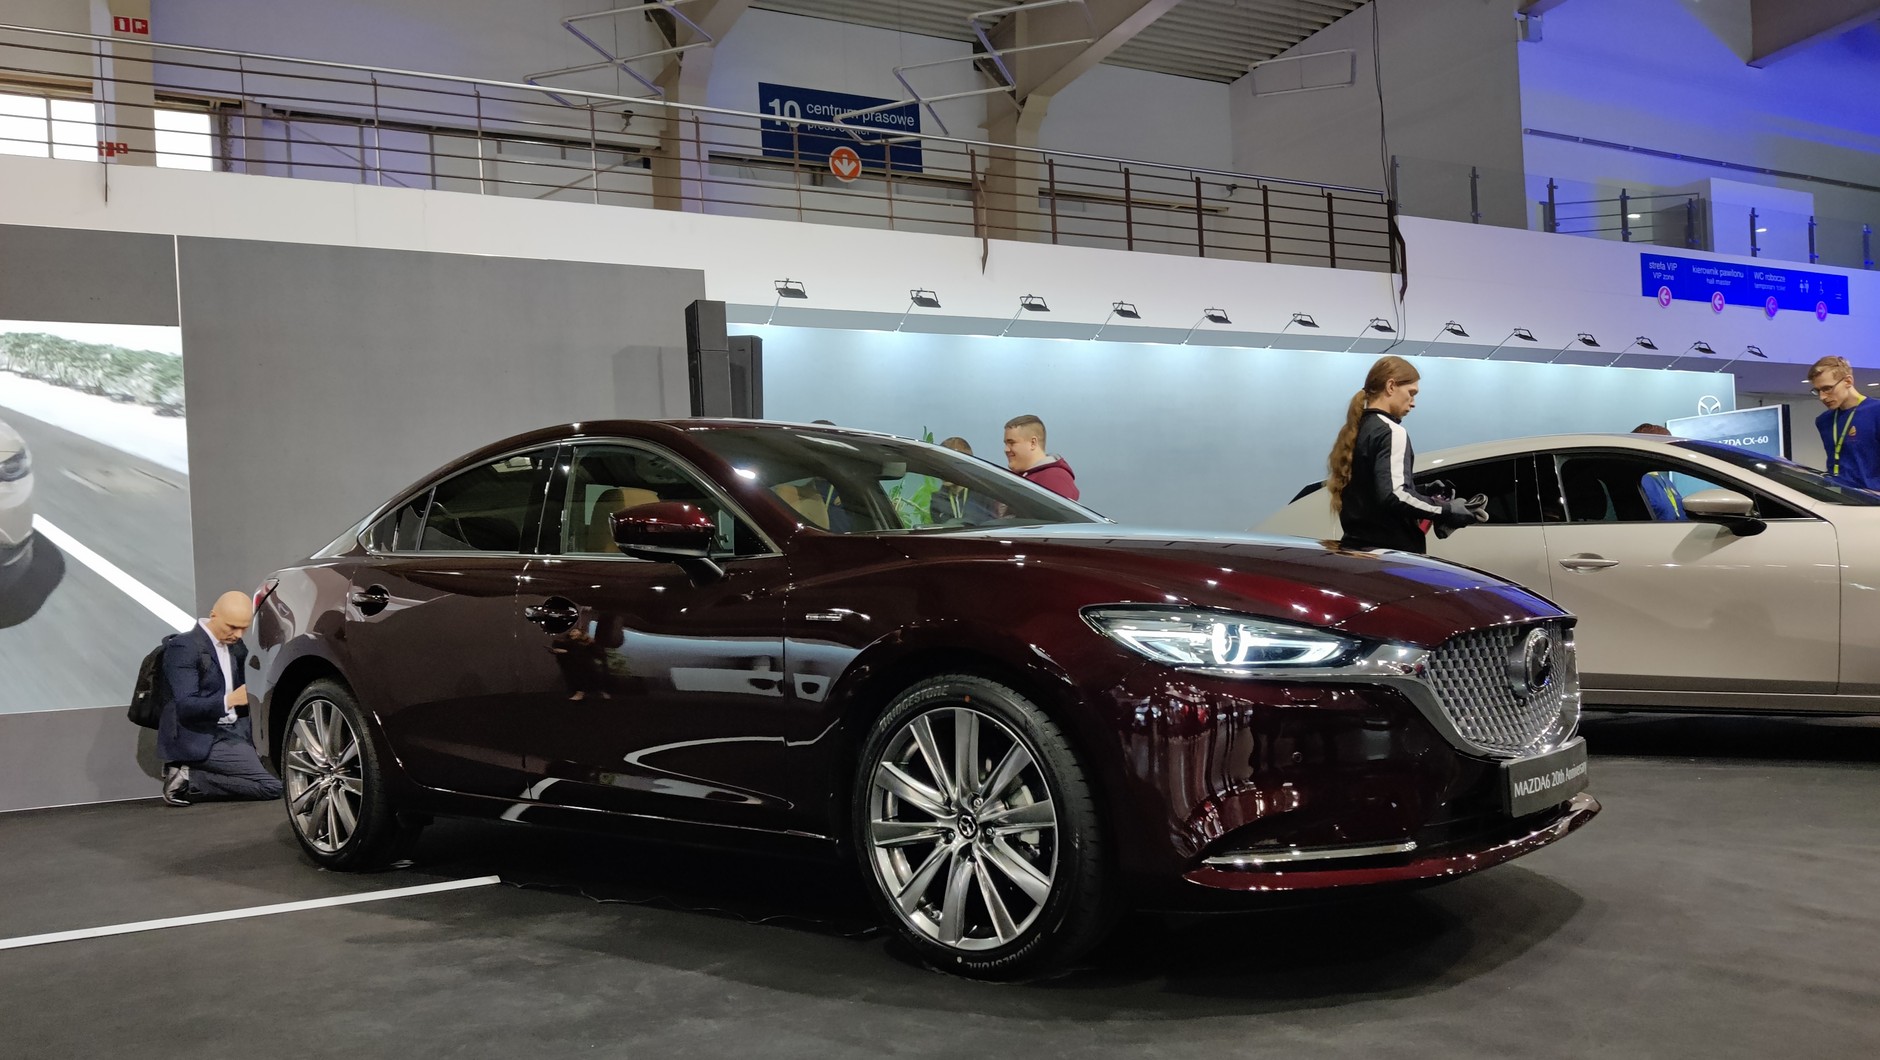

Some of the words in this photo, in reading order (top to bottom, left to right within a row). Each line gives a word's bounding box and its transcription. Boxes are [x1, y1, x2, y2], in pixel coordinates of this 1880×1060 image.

[769, 98, 801, 128] 10
[862, 112, 915, 127] prasowe
[1666, 262, 1678, 271] VIP
[1692, 265, 1719, 276] kierownik
[1719, 268, 1744, 278] pawilonu
[1663, 273, 1674, 281] zone
[1754, 272, 1764, 281] WC
[1765, 273, 1786, 283] robocze
[1743, 435, 1769, 445] CX-60
[879, 684, 949, 733] BRIDGESTONE
[1514, 773, 1551, 798] MAZDA6
[1551, 769, 1565, 787] 20th
[1565, 761, 1587, 781] Anniversary
